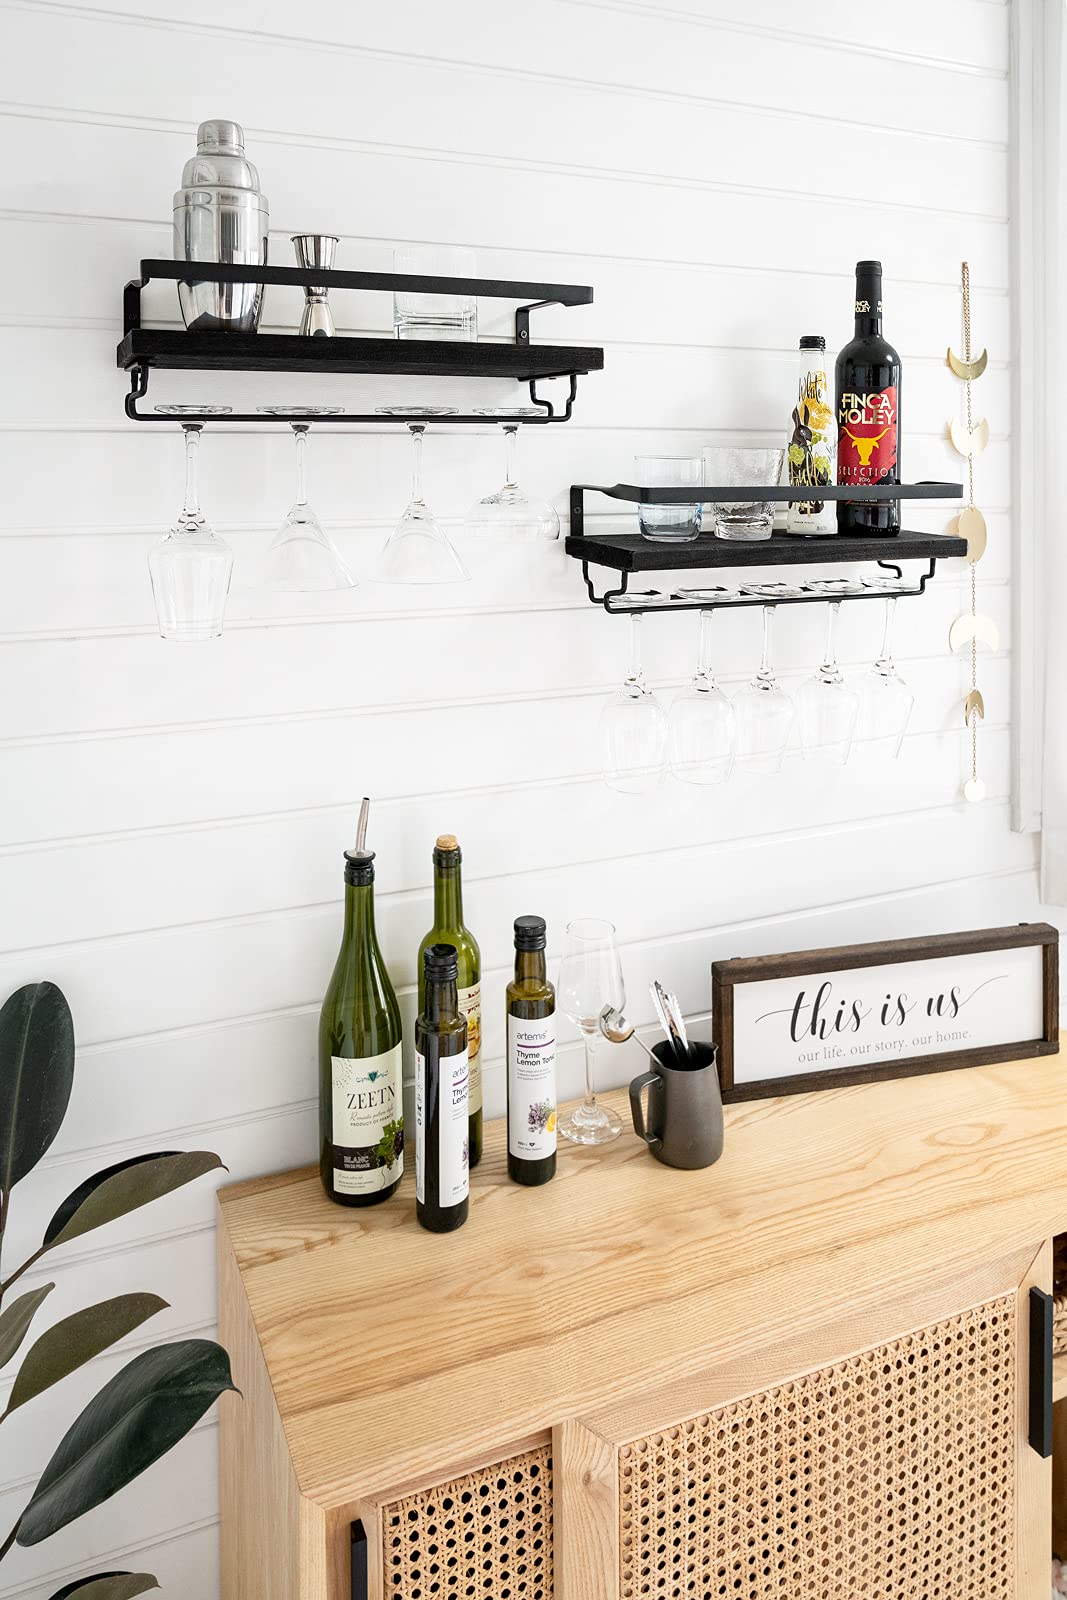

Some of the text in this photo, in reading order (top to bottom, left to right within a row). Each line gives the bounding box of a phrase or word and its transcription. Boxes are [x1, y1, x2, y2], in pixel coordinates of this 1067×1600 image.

[841, 393, 892, 410] FINCA
[839, 408, 895, 425] MOLEY
[755, 981, 872, 1043] this
[880, 993, 918, 1027] is
[516, 1049, 541, 1060] Thyme
[797, 1050, 820, 1064] our
[823, 1043, 847, 1060] life.
[849, 1042, 872, 1055] our
[911, 1035, 933, 1048] our
[516, 1057, 541, 1067] Lemon
[346, 1082, 395, 1110] ZEETN
[343, 1155, 369, 1164] BLANC
